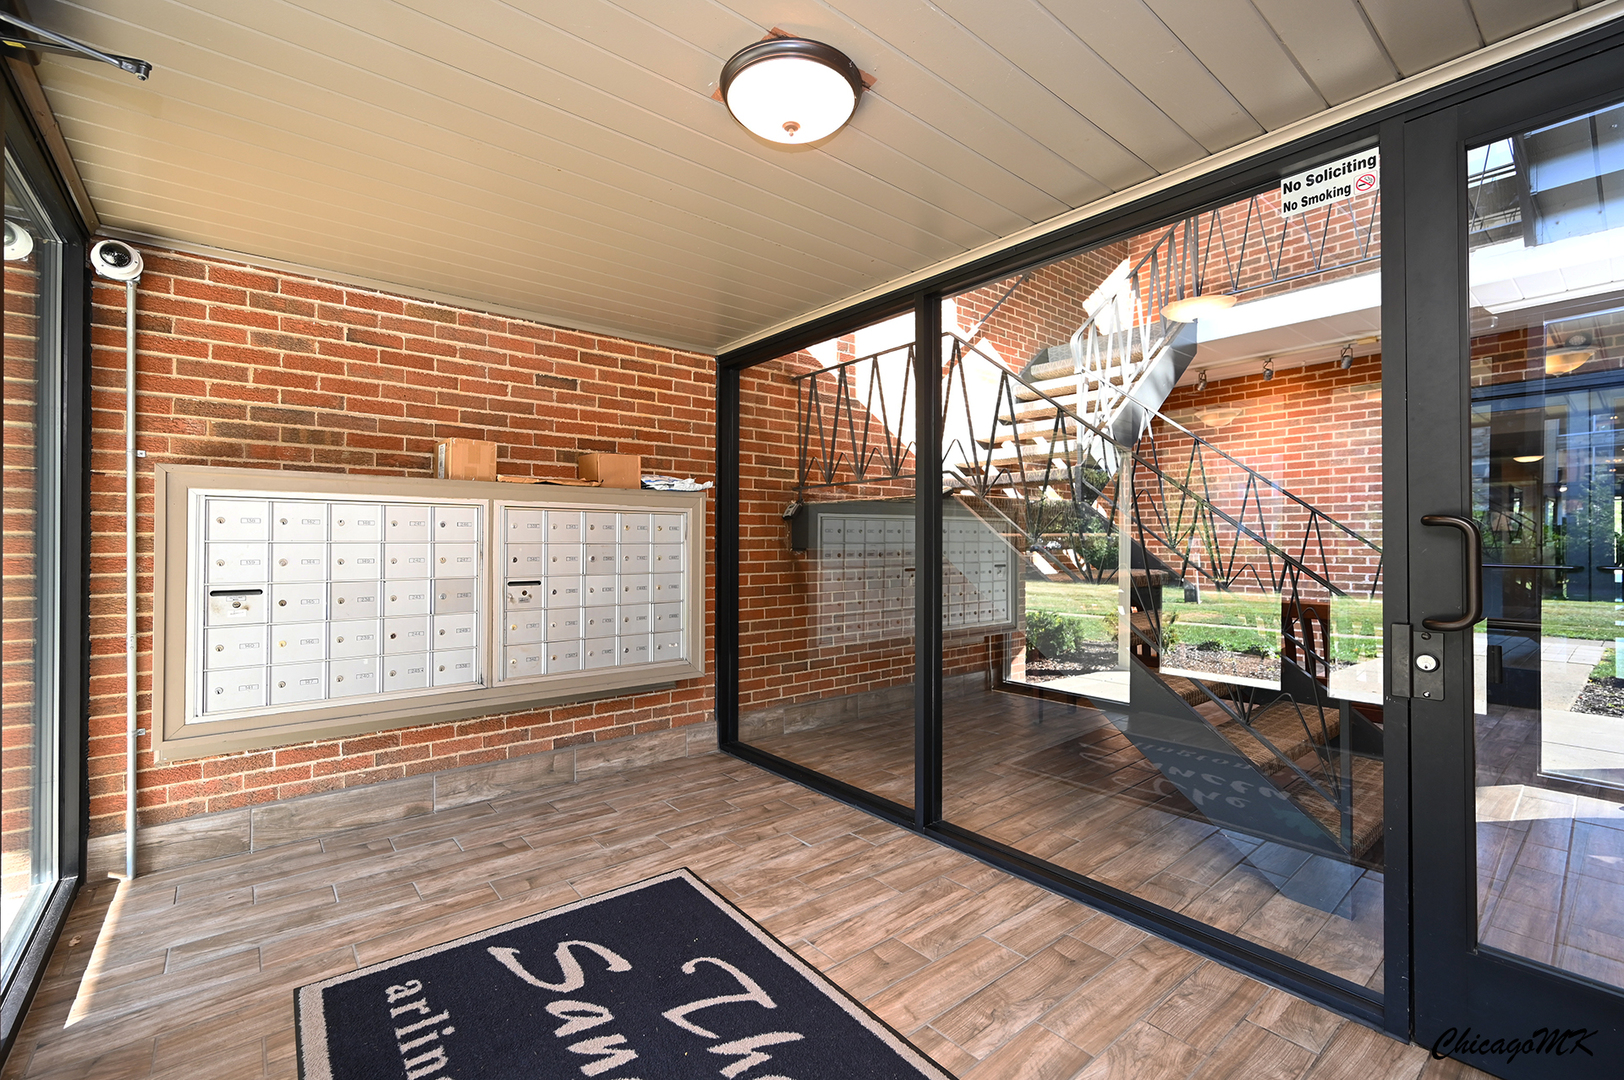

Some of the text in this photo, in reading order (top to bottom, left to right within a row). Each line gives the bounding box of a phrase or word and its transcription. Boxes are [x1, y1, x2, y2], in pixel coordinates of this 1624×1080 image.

[1282, 155, 1377, 195] No Soliciting
[1282, 184, 1352, 214] No Smoking
